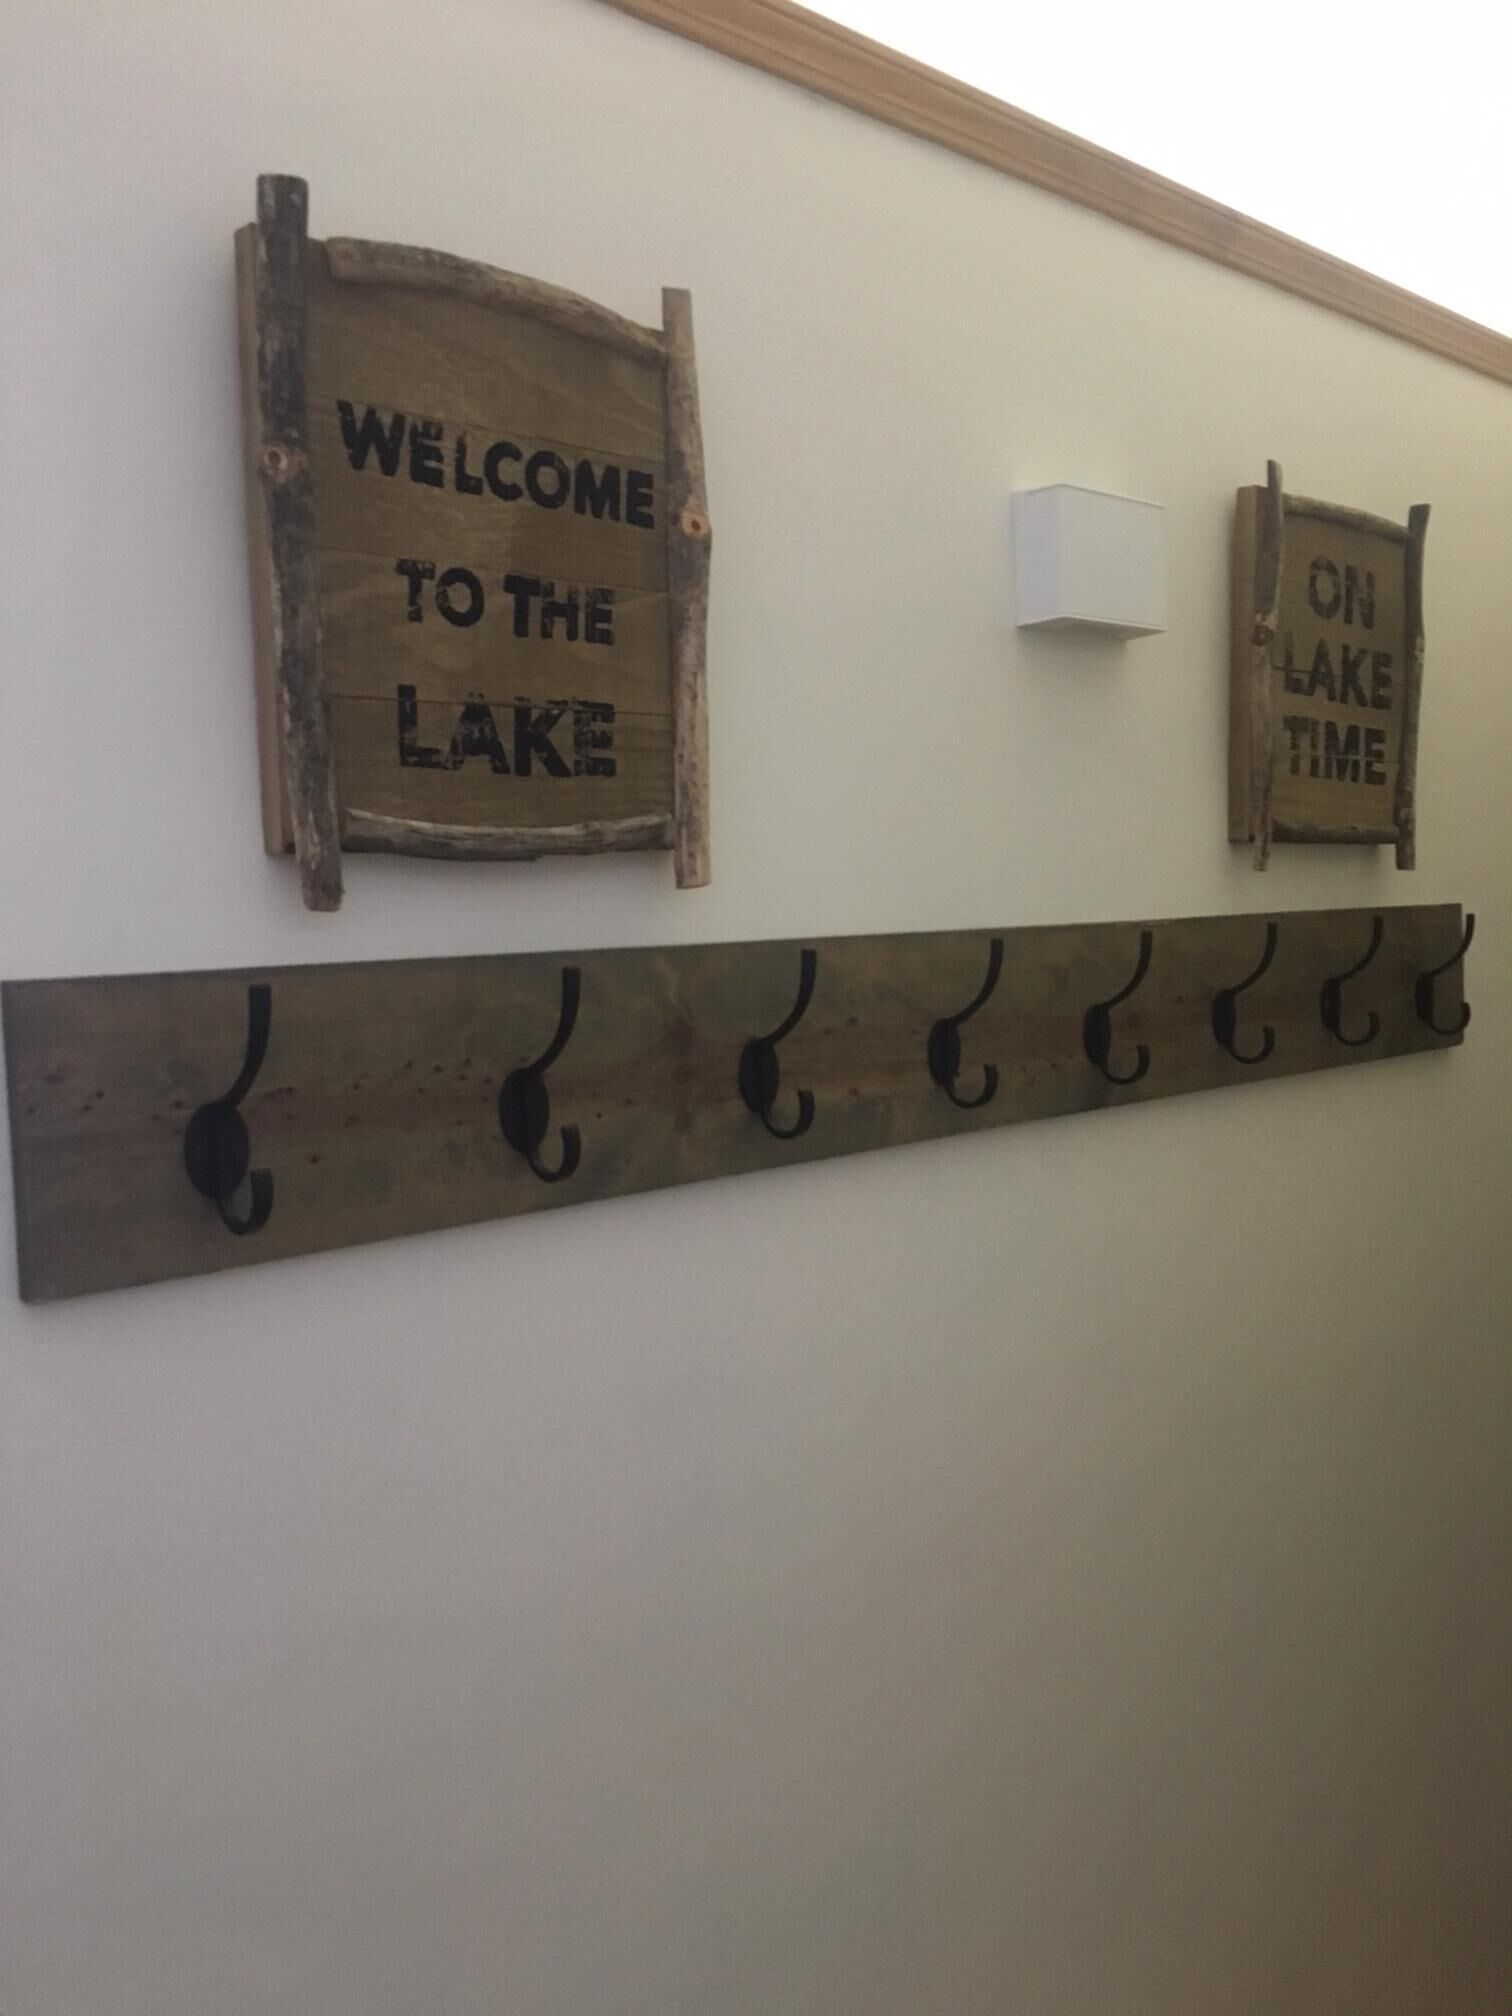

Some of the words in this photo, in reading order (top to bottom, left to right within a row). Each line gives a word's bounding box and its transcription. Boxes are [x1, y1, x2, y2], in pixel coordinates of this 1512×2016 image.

[337, 400, 655, 529] WELCOME
[395, 558, 485, 627] TO
[503, 574, 615, 645] THE
[1309, 555, 1376, 630] ON
[1284, 631, 1393, 711] LAKE
[397, 683, 617, 778] LAKE
[1283, 715, 1387, 786] TIME
